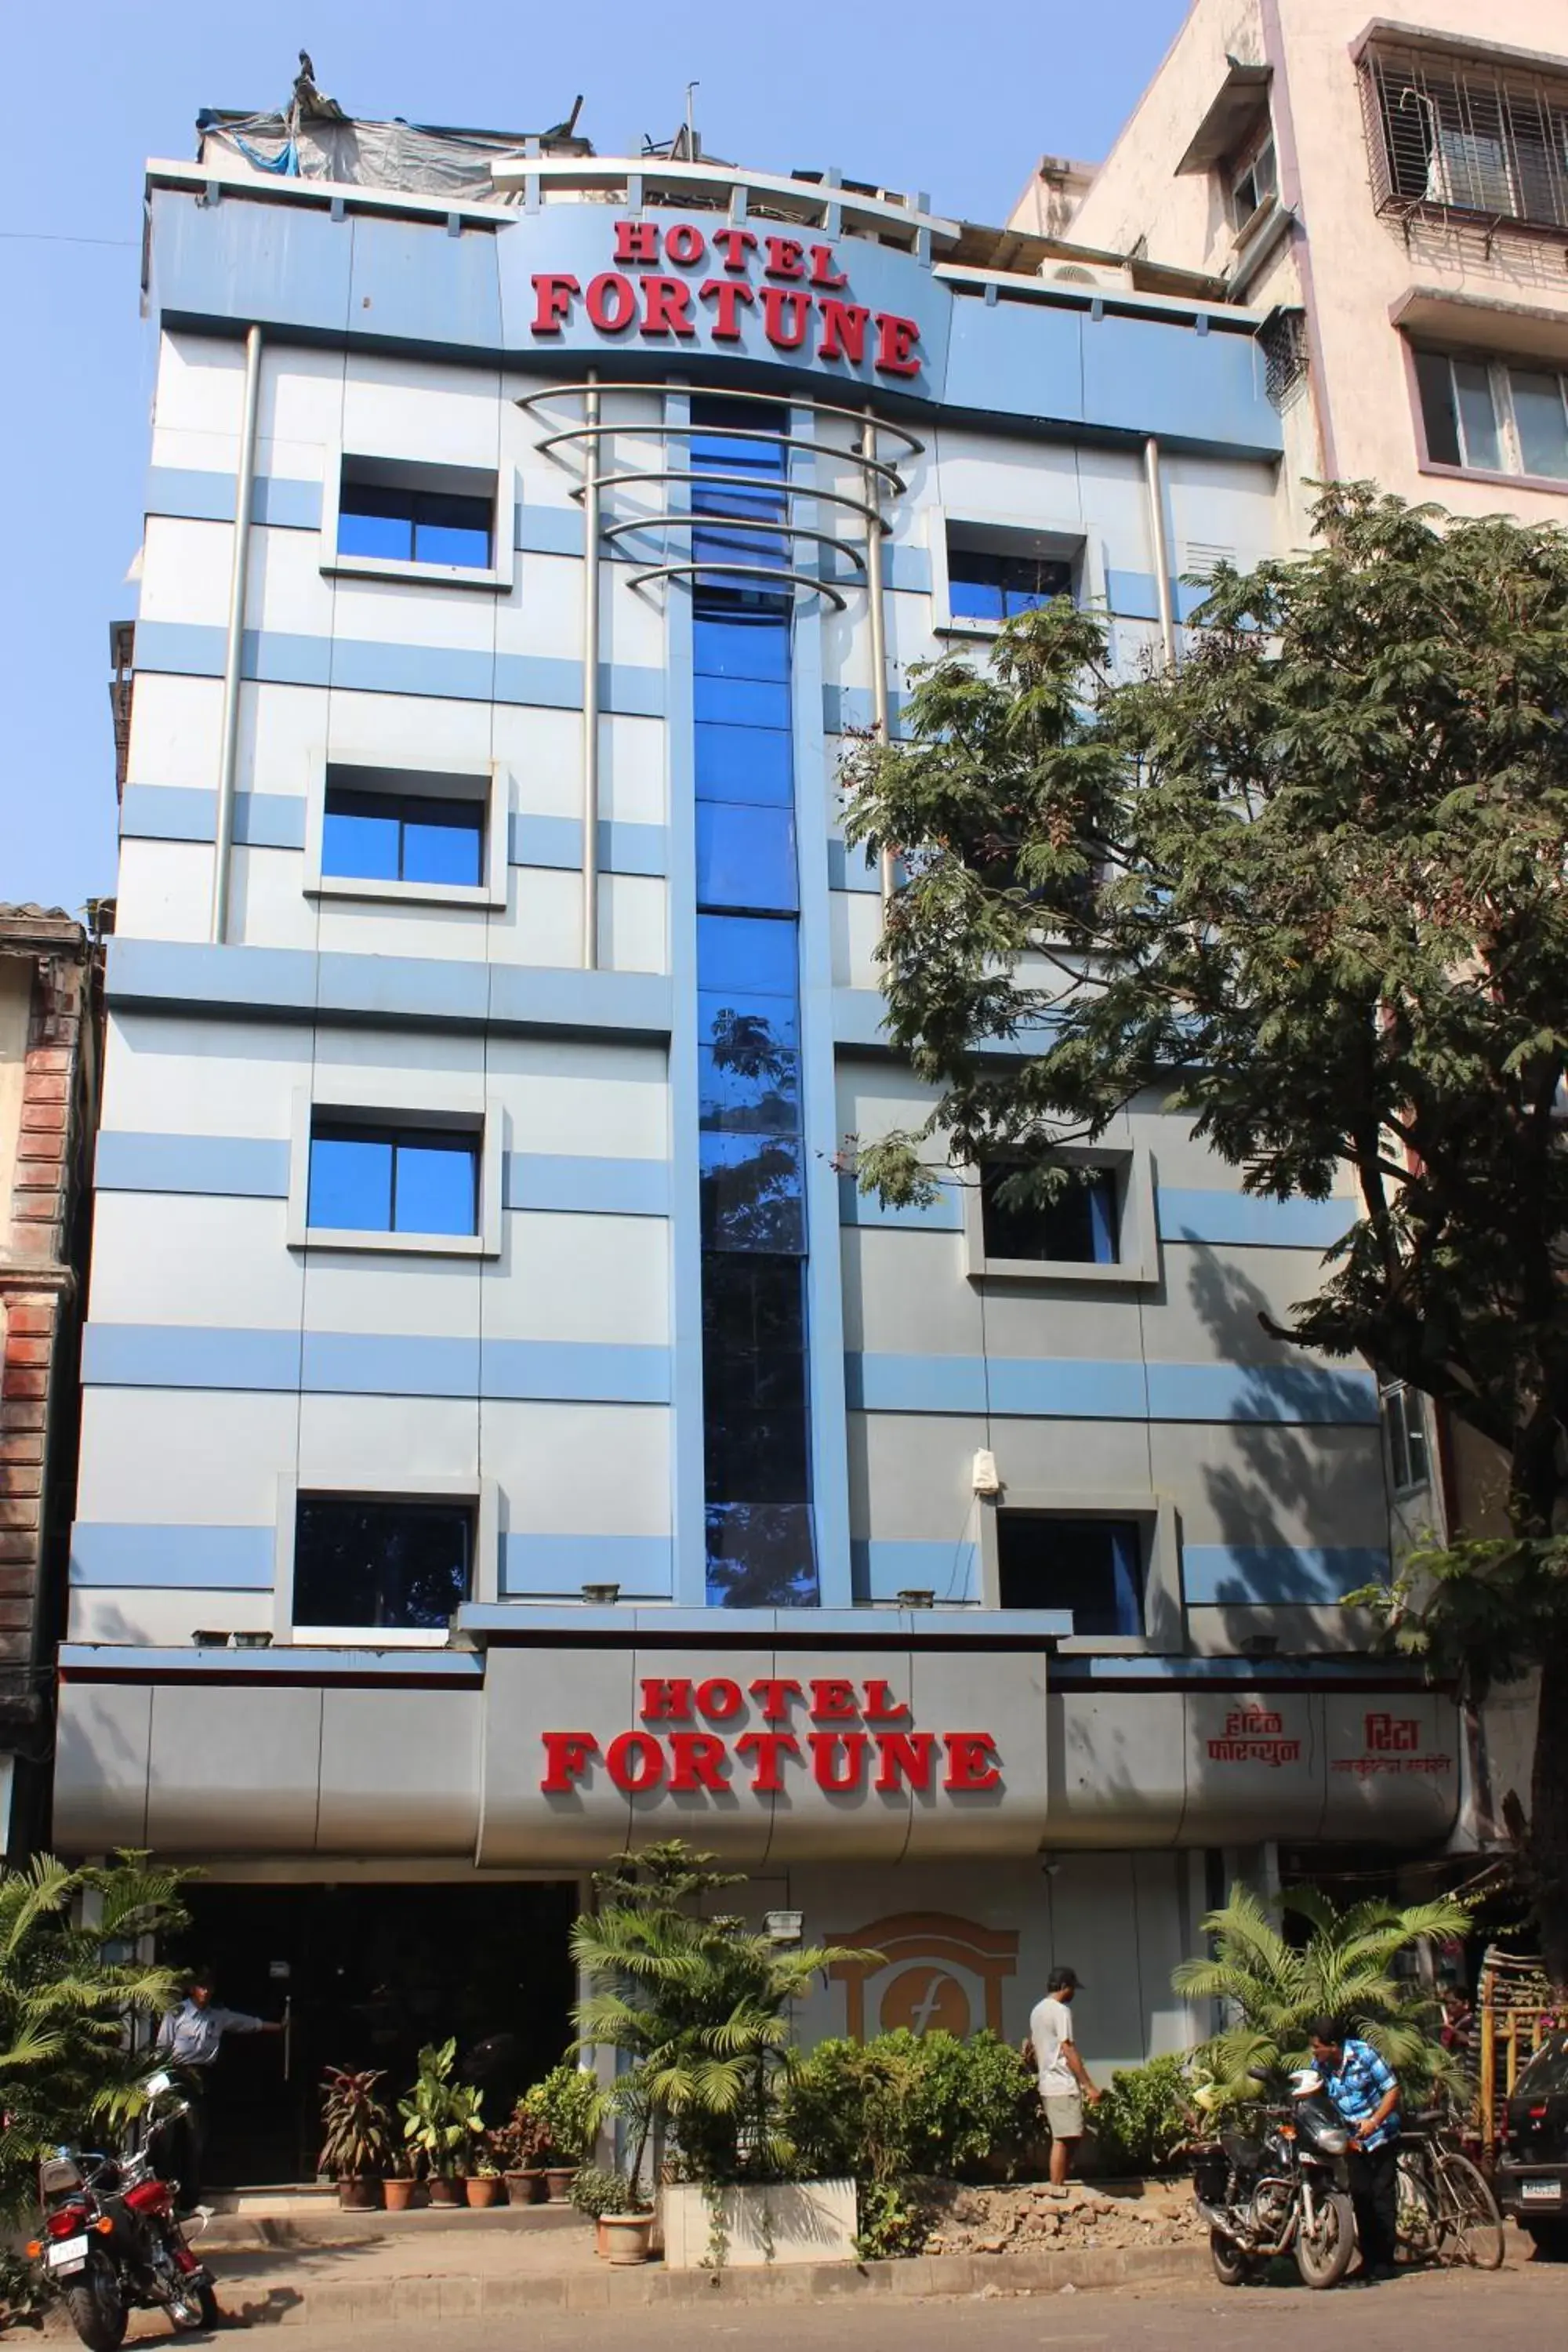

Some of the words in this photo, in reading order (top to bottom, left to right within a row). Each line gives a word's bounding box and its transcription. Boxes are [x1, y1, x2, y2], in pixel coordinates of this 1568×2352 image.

[612, 221, 848, 289] HOTEL
[530, 272, 922, 377] FORTUNE
[640, 1678, 910, 1721] HOTEL
[540, 1730, 1001, 1793] FORTUNE
